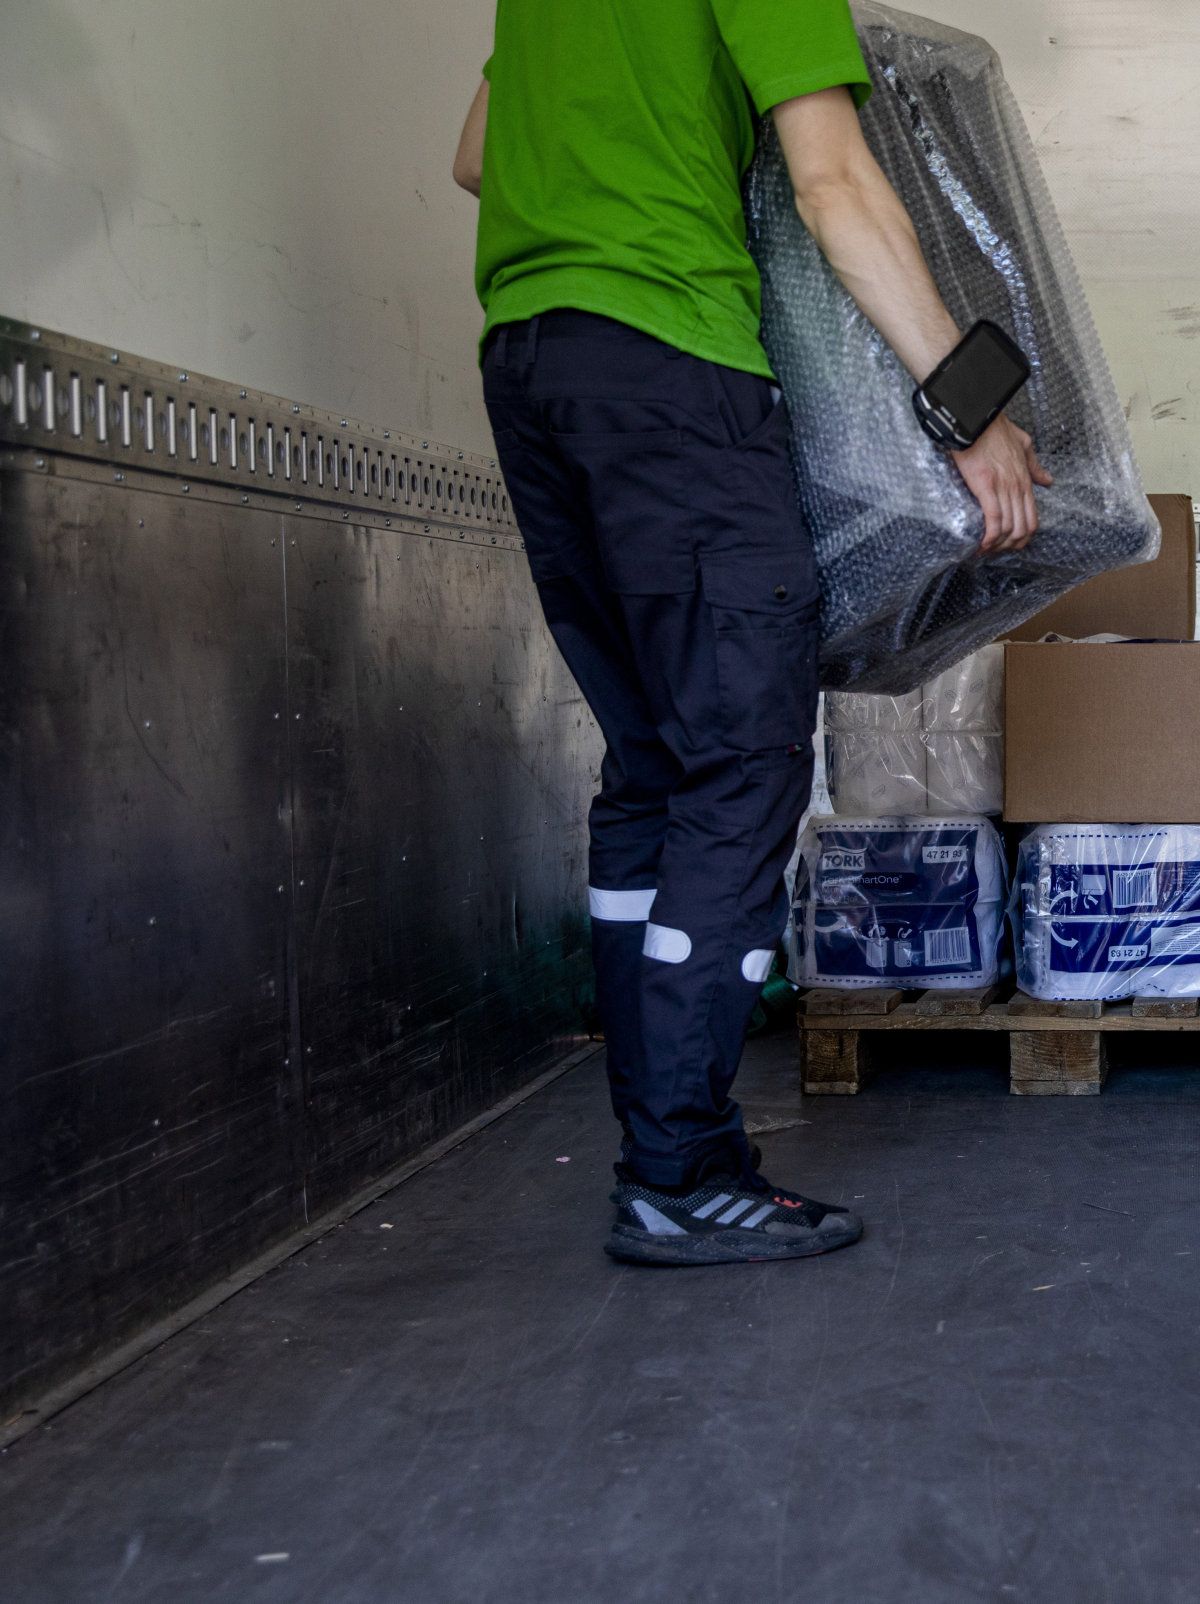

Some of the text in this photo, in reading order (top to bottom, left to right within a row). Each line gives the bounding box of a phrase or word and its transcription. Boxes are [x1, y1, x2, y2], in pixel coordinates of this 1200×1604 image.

[926, 850, 938, 859] 47
[940, 850, 949, 859] 21
[824, 855, 863, 868] TORK
[1123, 949, 1133, 957] 21
[1135, 949, 1146, 957] 47
